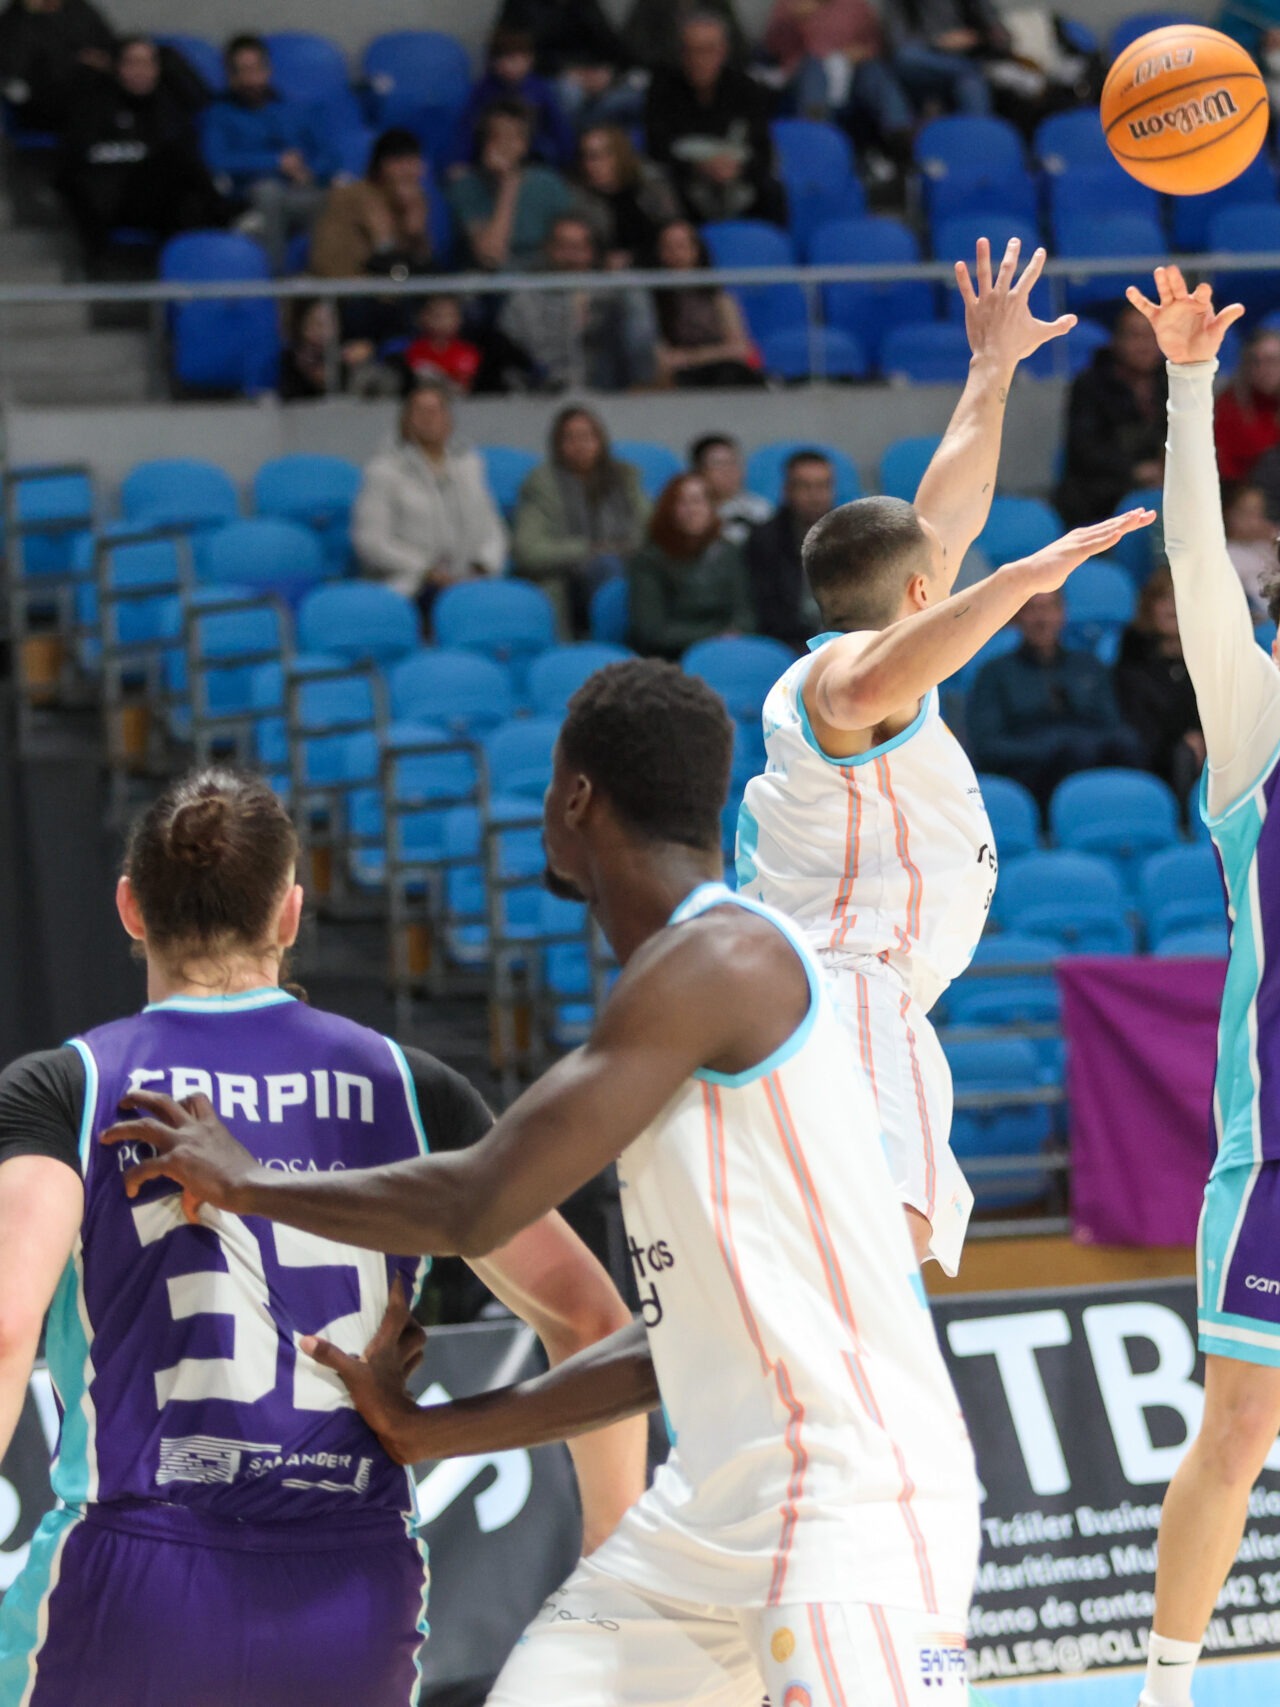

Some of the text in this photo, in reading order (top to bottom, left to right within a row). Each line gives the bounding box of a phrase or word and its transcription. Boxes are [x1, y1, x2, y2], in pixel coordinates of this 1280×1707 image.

[1128, 89, 1239, 141] Wilson
[1075, 1499, 1163, 1538] Busine
[1040, 1595, 1078, 1630] de
[1080, 1589, 1156, 1625] conta
[1216, 1574, 1260, 1610] 42
